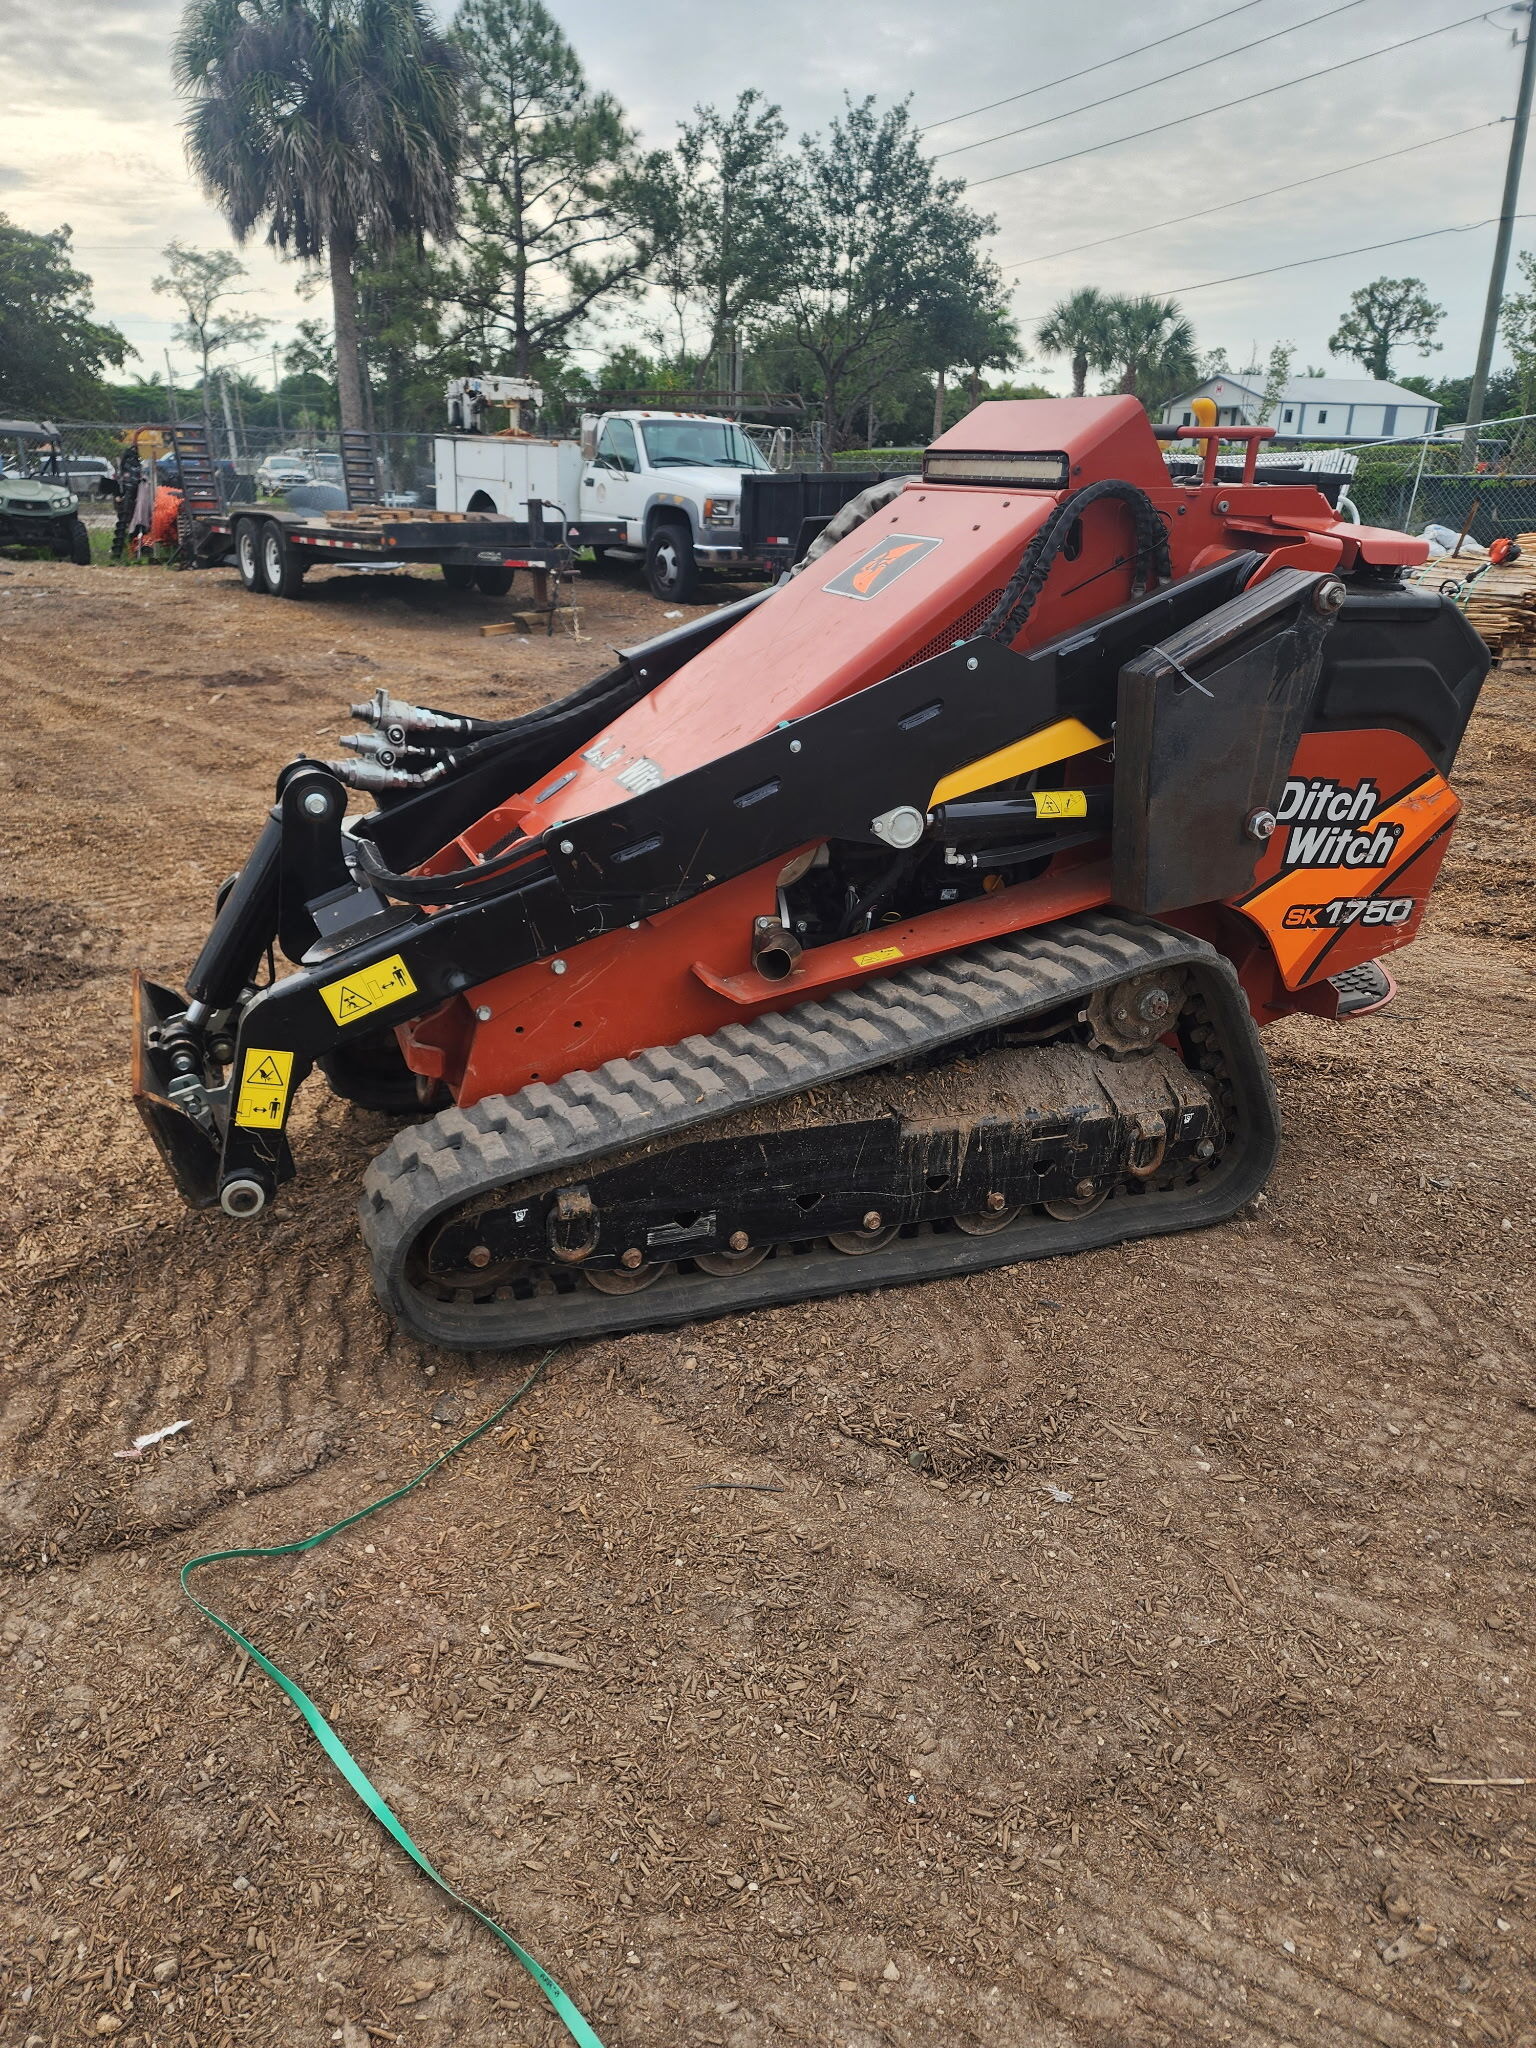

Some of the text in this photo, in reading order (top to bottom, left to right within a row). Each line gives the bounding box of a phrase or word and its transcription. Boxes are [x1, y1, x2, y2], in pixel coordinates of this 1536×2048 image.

[1276, 781, 1378, 822] Ditch
[1286, 826, 1395, 865] Witch
[1285, 899, 1413, 926] SK 1750
